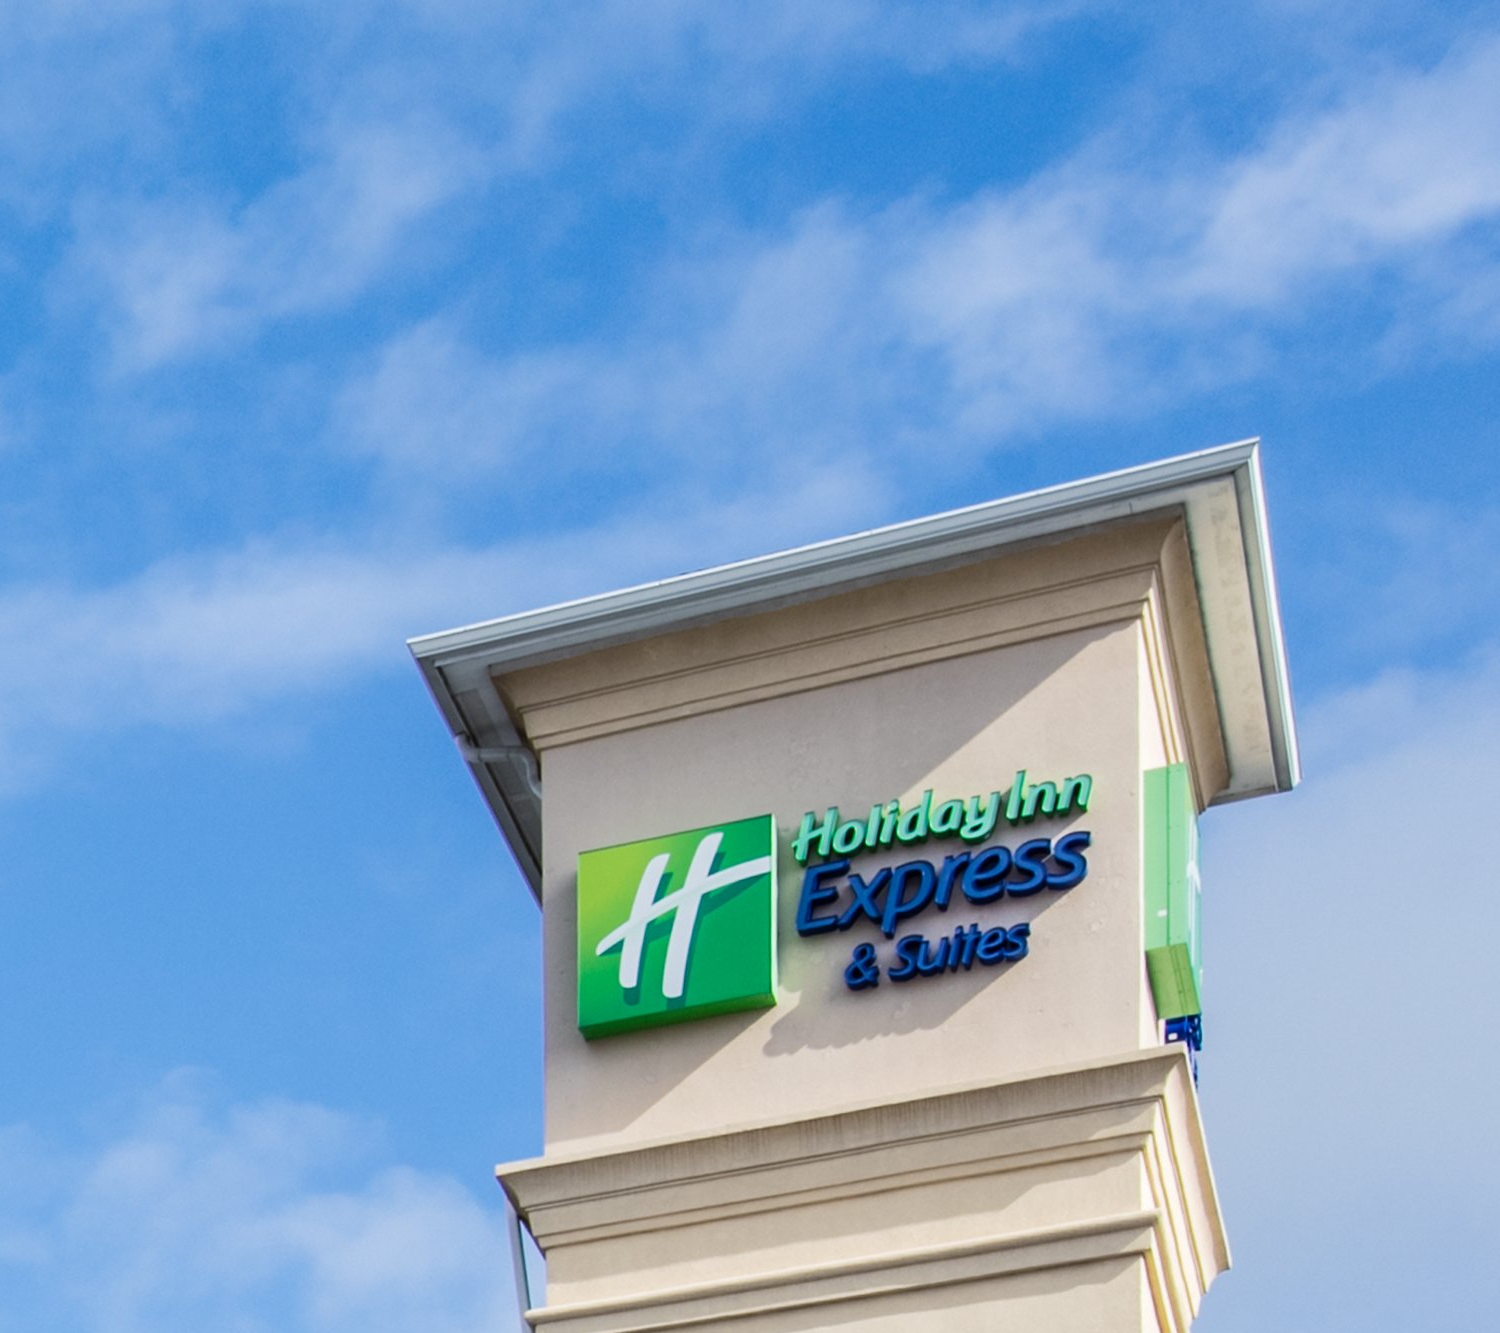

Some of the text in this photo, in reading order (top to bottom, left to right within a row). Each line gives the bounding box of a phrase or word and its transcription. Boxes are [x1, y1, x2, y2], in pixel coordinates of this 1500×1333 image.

[791, 769, 1093, 864] Holiday Inn
[796, 831, 1092, 939] Express
[844, 921, 1030, 990] & Suites
